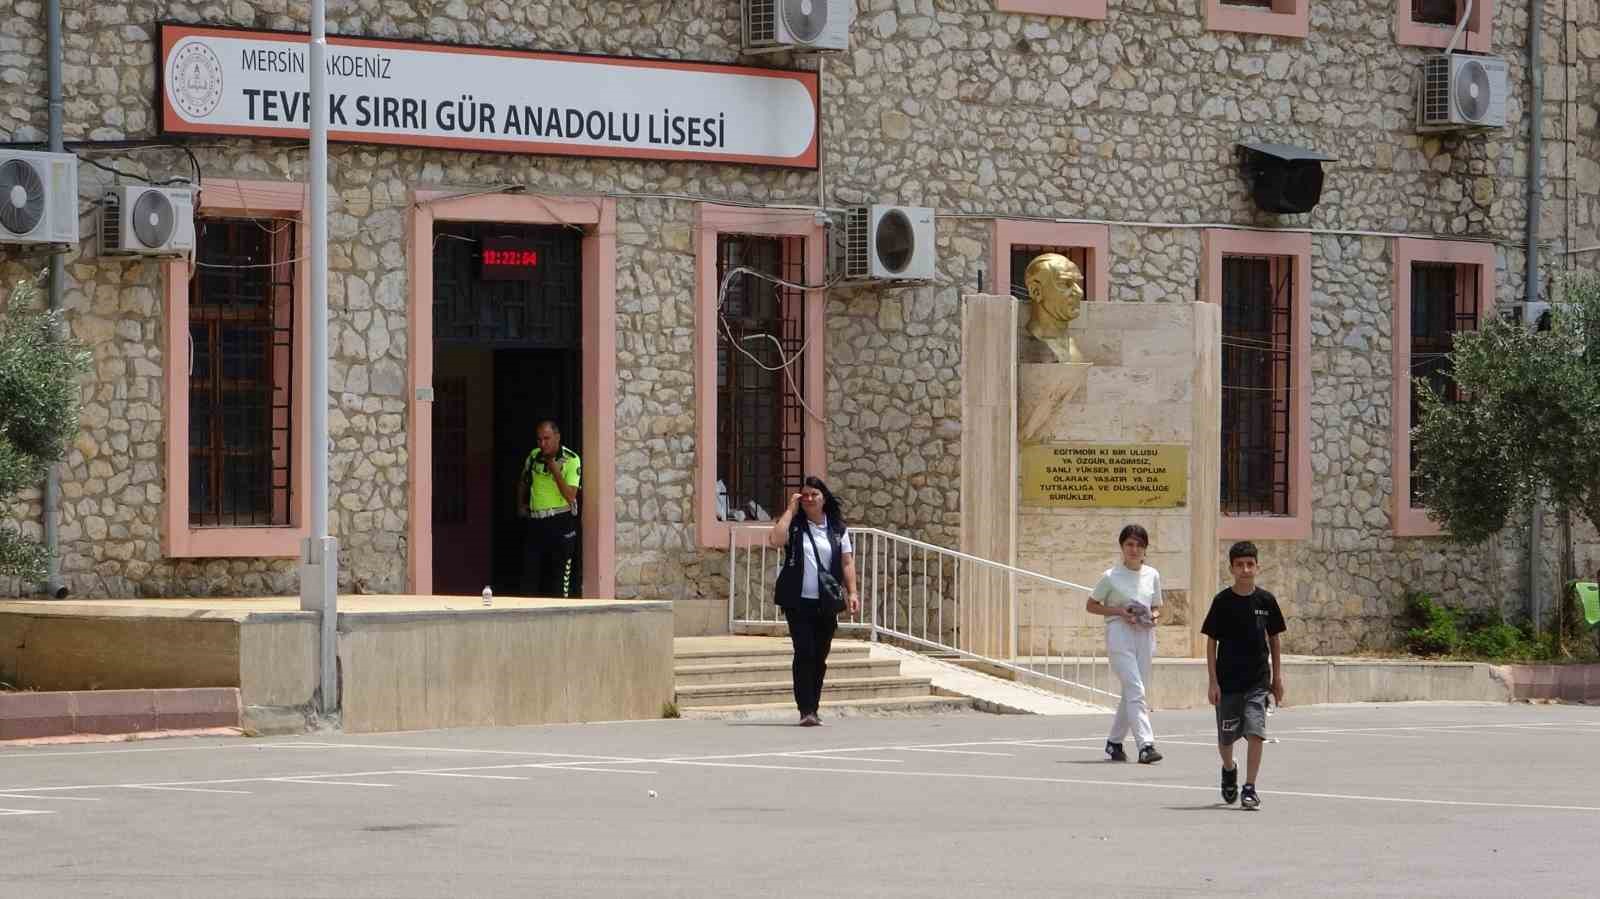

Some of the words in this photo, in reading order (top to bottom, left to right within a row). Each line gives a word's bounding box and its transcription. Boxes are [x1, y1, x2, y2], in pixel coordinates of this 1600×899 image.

[242, 48, 305, 73] MERSİN
[243, 88, 348, 125] TEVFK
[355, 95, 427, 129] SIRRI
[436, 94, 496, 133] GÜR
[503, 104, 641, 143] ANADOLU
[648, 107, 725, 148] LİSESİ
[1132, 466, 1167, 474] TOPLUM
